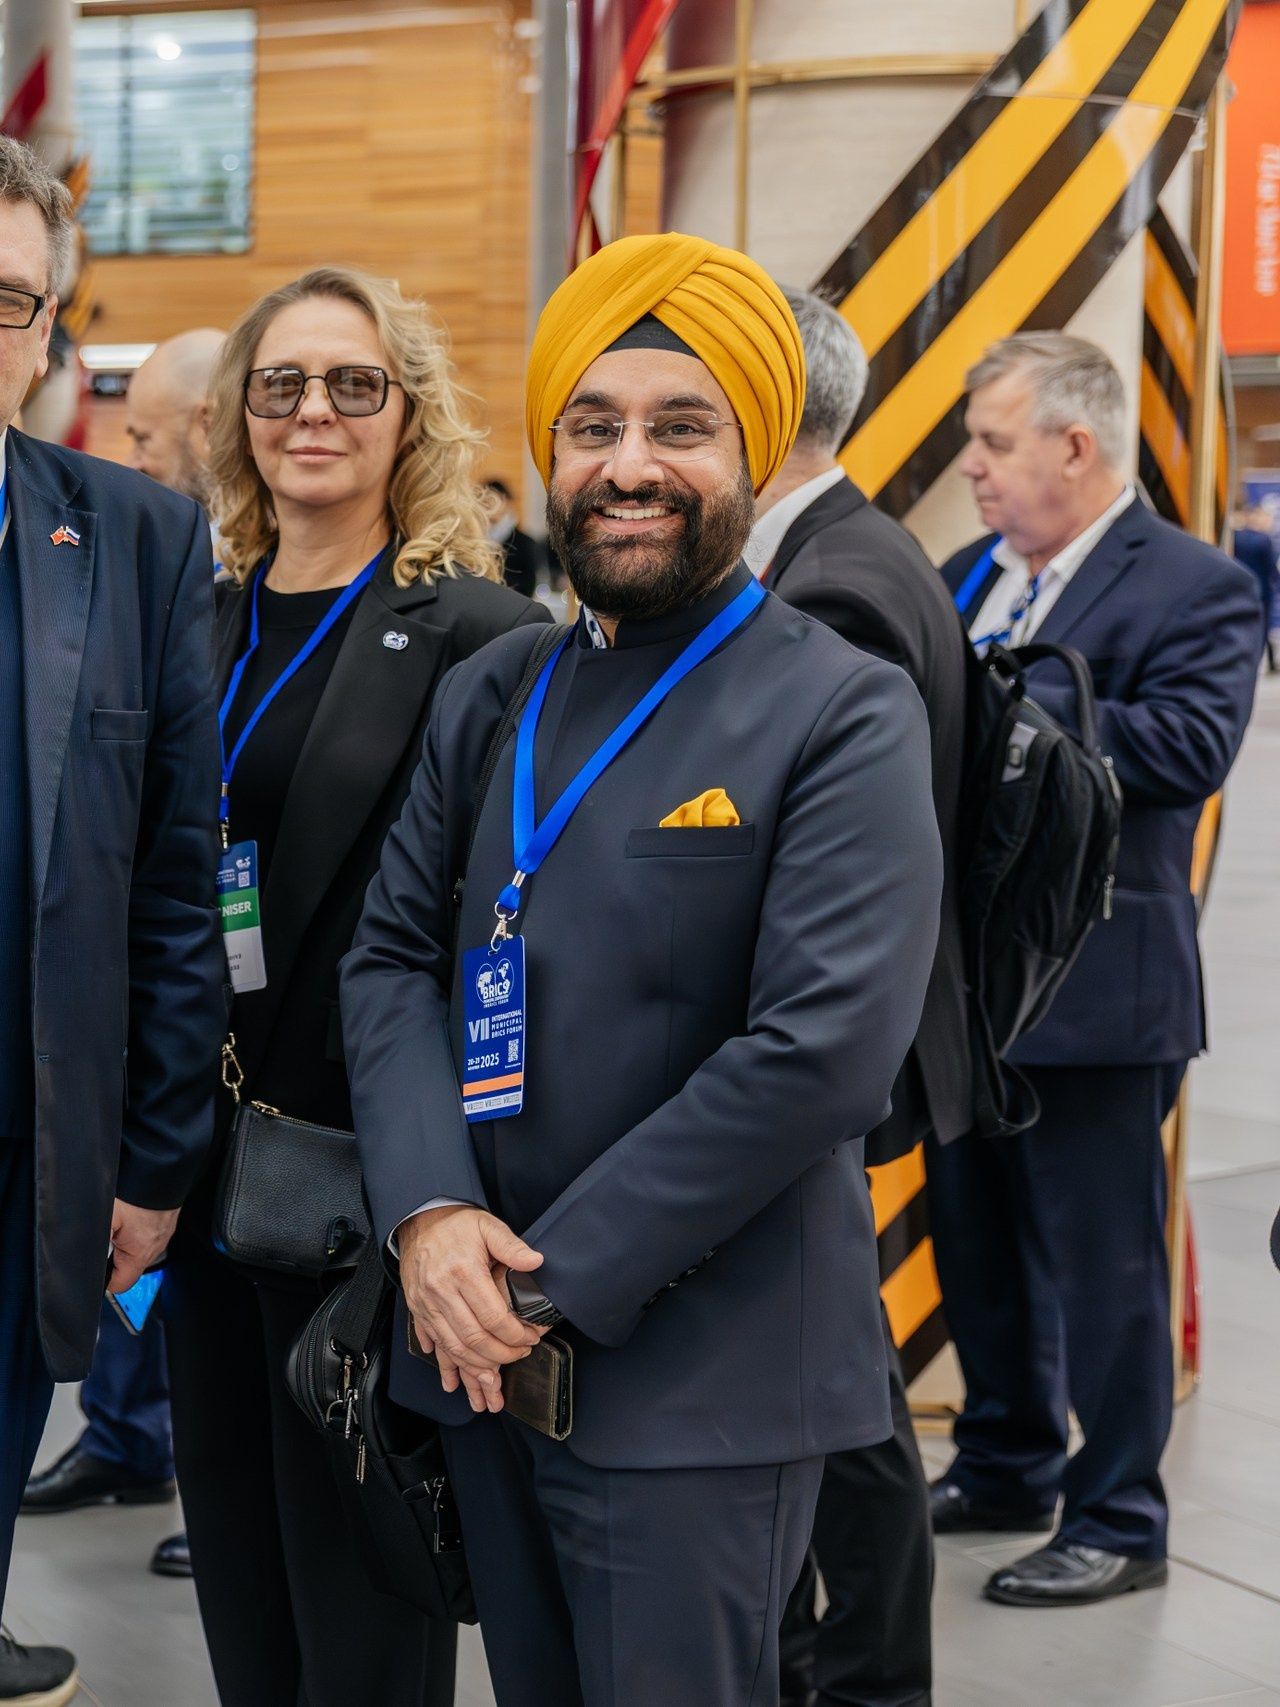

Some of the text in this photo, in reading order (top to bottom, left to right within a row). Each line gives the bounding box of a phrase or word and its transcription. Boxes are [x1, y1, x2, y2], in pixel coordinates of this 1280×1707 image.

[218, 900, 252, 918] NISER
[483, 982, 510, 1000] BRICS
[468, 1017, 490, 1043] VII
[491, 1017, 522, 1031] MUNICIPAL
[491, 1025, 522, 1039] BRICS FORUM
[480, 1052, 500, 1068] 2025
